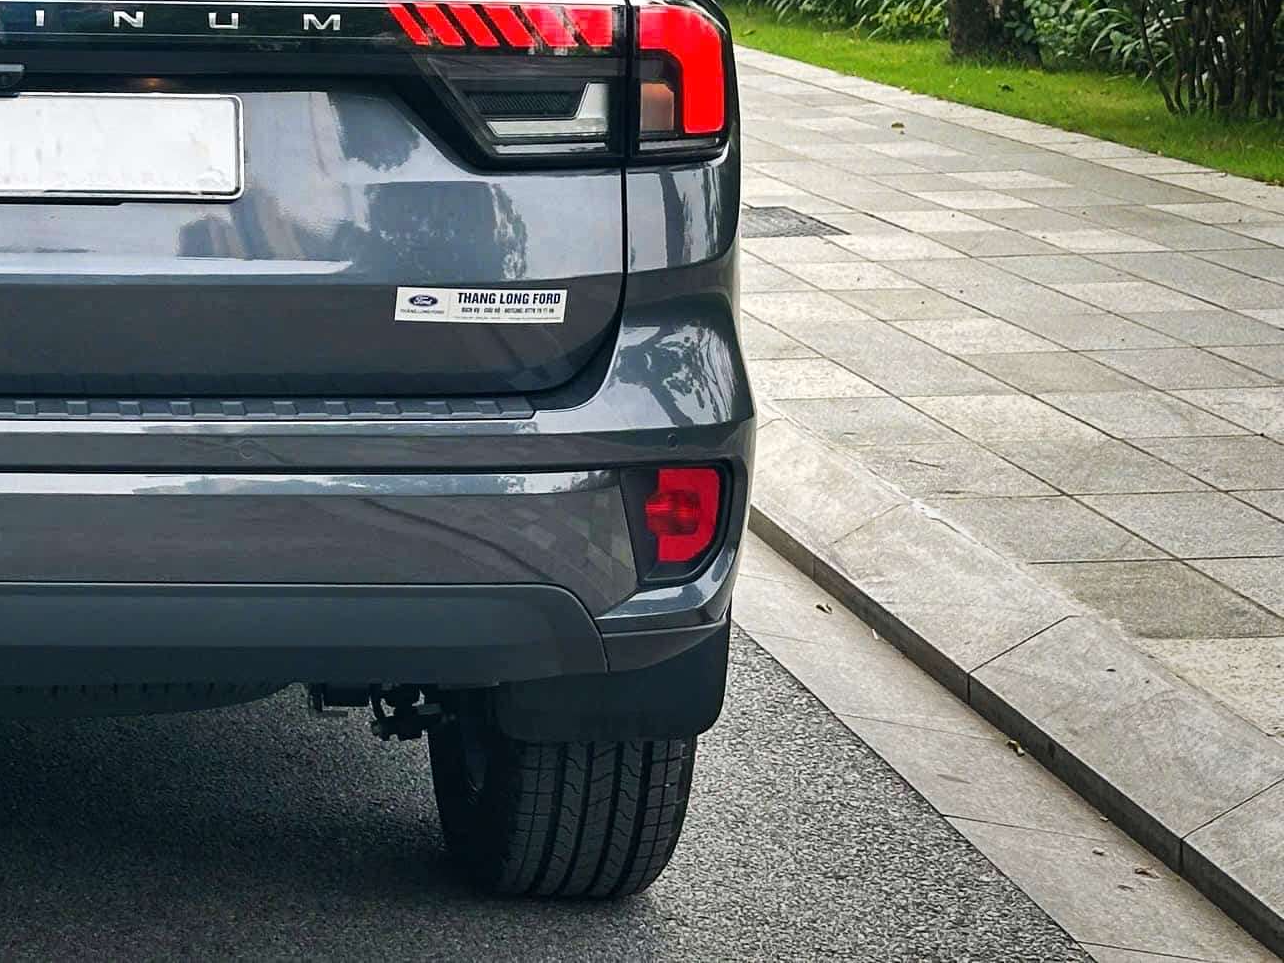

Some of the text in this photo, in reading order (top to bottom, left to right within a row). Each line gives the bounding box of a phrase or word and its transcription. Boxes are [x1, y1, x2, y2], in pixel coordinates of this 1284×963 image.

[457, 292, 561, 305] THANG LONG FORD
